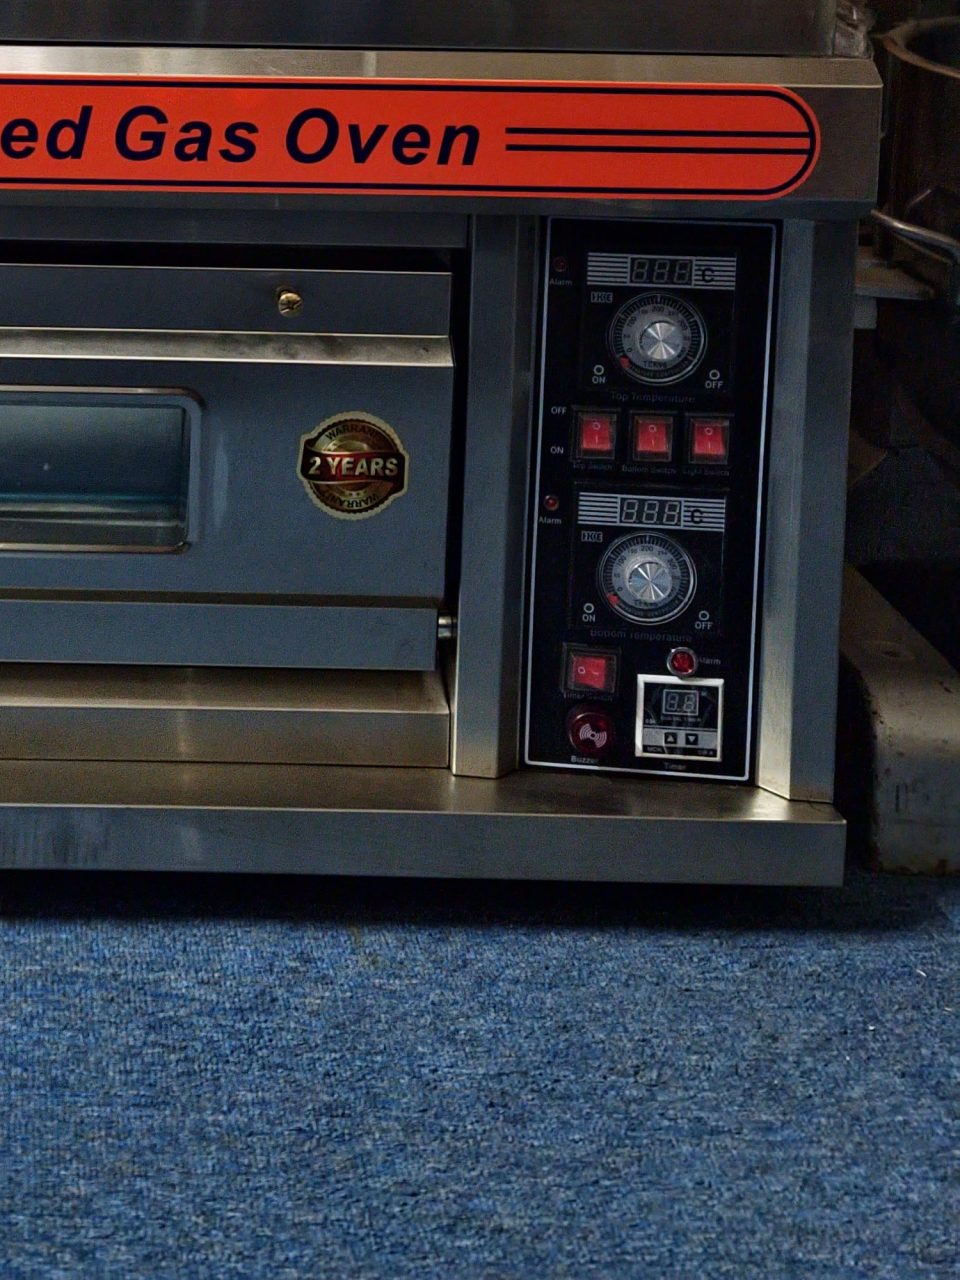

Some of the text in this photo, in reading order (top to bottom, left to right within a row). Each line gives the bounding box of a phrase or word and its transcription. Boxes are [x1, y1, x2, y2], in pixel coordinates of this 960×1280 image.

[115, 105, 259, 163] Gas
[285, 108, 481, 166] Oven
[548, 277, 573, 286] Alarm
[591, 375, 606, 384] ON
[705, 381, 723, 389] OFF
[611, 391, 628, 401] Top
[550, 407, 568, 415] OFF
[550, 446, 564, 455] ON
[307, 456, 399, 477] 2 YEARS
[539, 516, 562, 525] Alarm
[582, 614, 596, 623] ON
[695, 622, 713, 630] OFF
